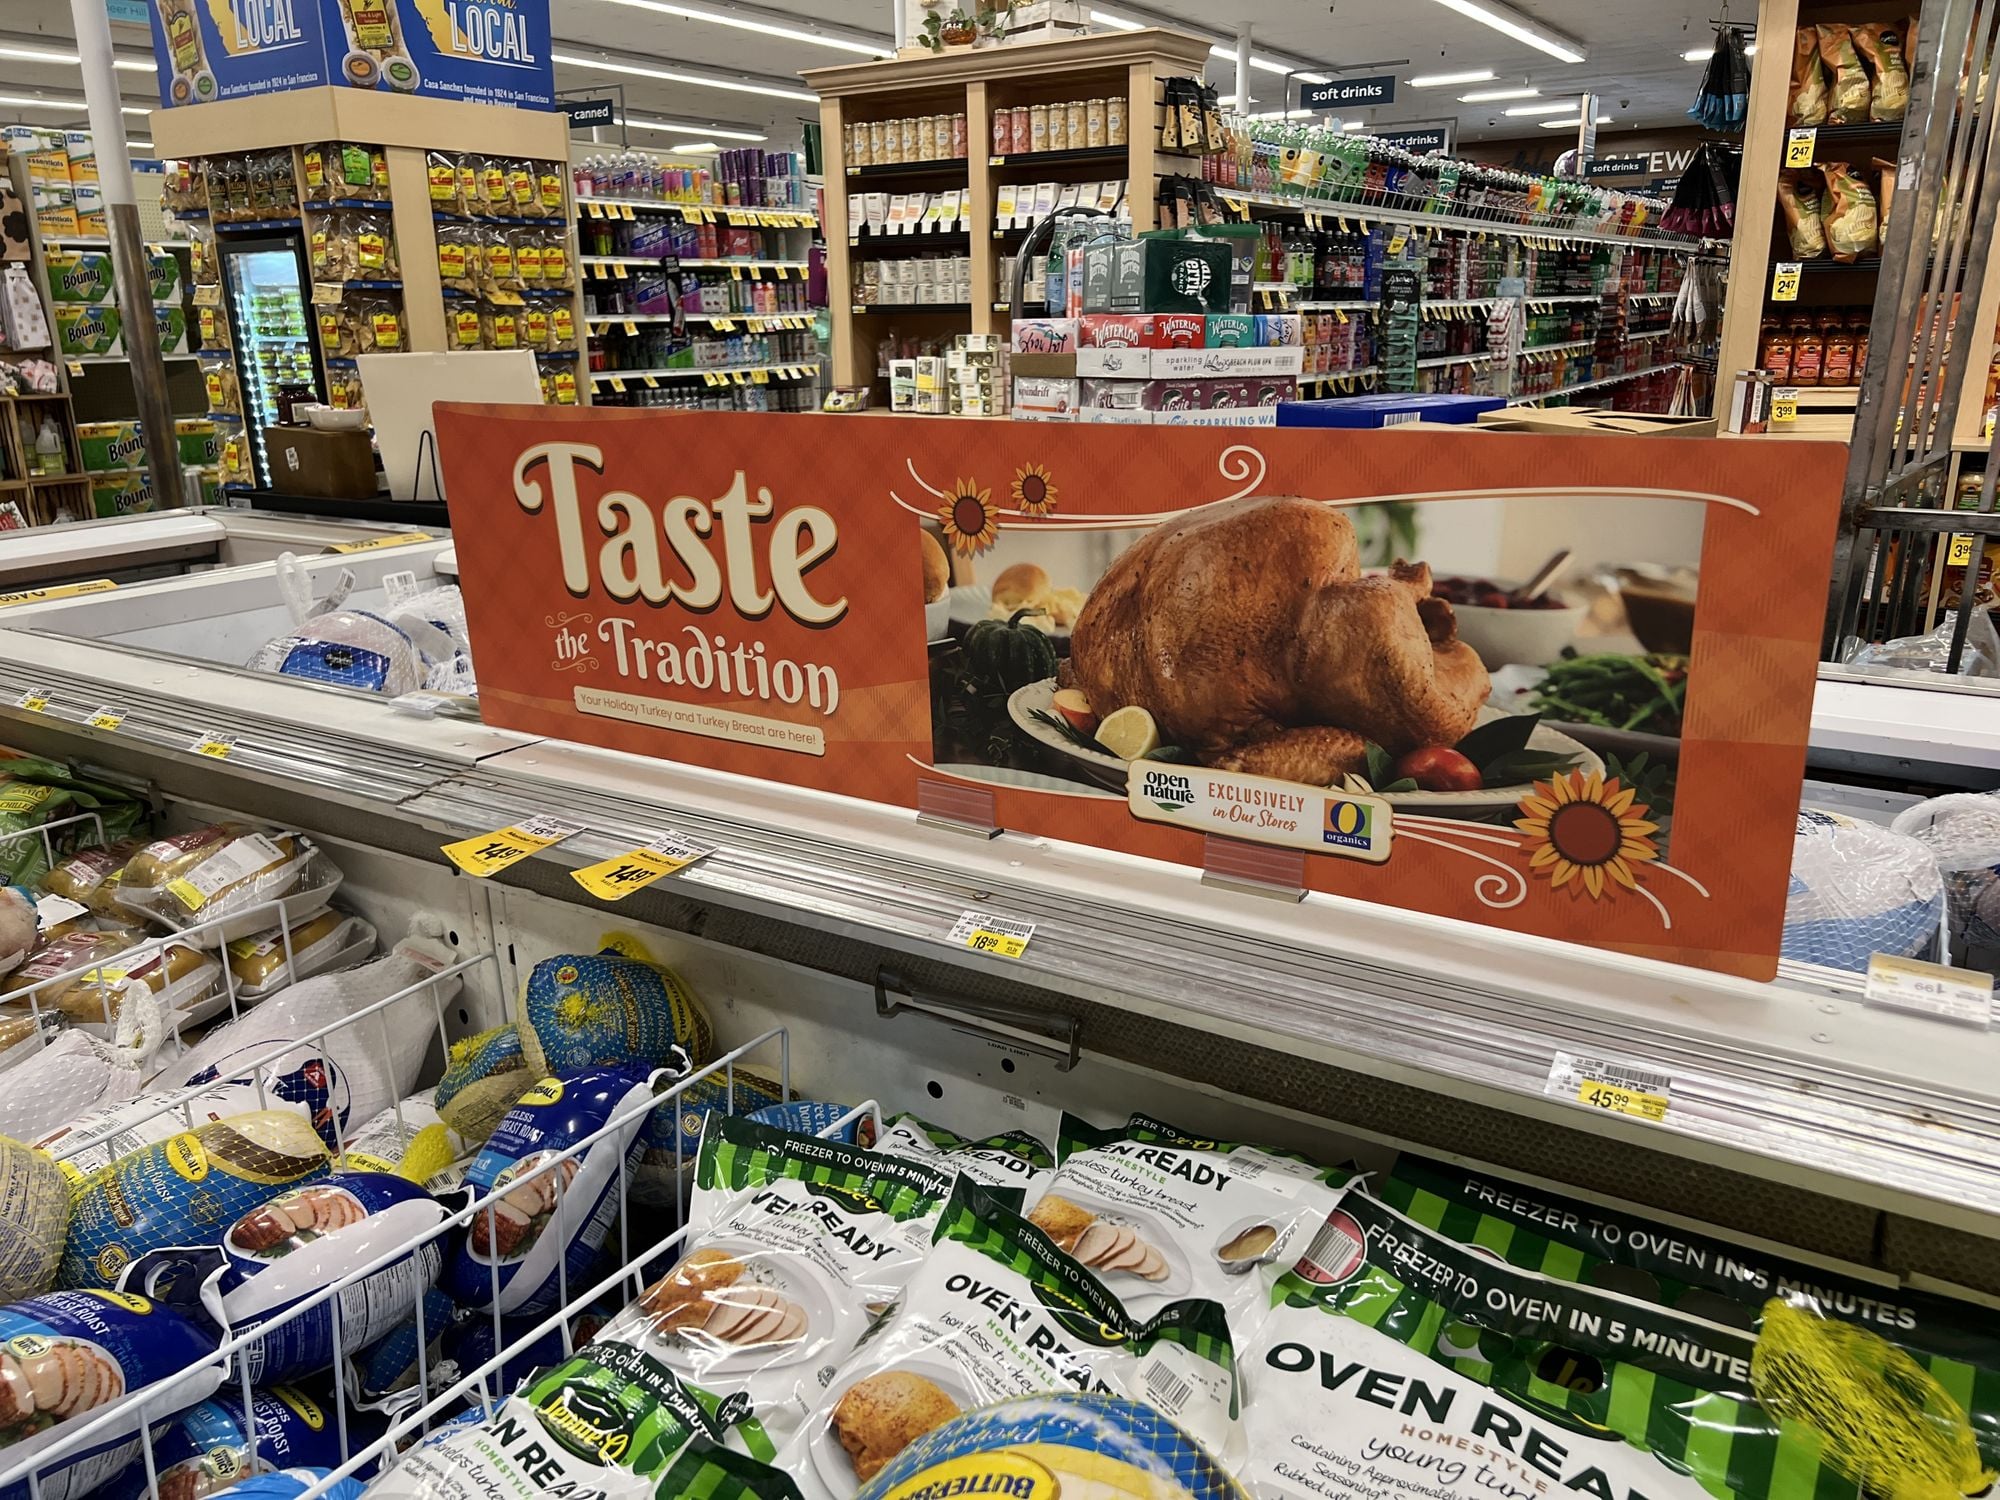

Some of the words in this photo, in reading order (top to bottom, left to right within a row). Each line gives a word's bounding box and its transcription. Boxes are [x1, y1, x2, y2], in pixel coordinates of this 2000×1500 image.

[234, 0, 301, 49] LOCAL
[449, 2, 535, 63] LOCAL
[231, 81, 249, 94] Sanchez
[249, 80, 266, 92] founded
[271, 76, 282, 88] 1924
[288, 74, 296, 86] San
[296, 72, 318, 84] Francisco
[424, 78, 439, 91] Casa
[439, 80, 463, 94] Sanchez
[464, 84, 486, 96] founded
[487, 87, 494, 97] in
[494, 88, 507, 98] 1924
[508, 89, 514, 99] in
[514, 90, 525, 101] San
[525, 92, 549, 104] Francisco
[1312, 88, 1339, 101] soft
[1340, 85, 1383, 99] drinks
[574, 106, 609, 121] canned
[1406, 136, 1439, 146] drinks
[1592, 164, 1610, 173] soft
[1611, 163, 1640, 172] drinks
[62, 268, 101, 290] Bounty
[68, 320, 106, 343] Bounty
[1092, 320, 1139, 348] WATERLOO
[1159, 316, 1201, 339] WATERLOO
[1209, 315, 1249, 339] WATERLOO
[1166, 356, 1203, 366] sparkling
[1018, 386, 1050, 398] spindrift
[1193, 416, 1255, 426] SPARKLING
[108, 435, 145, 463] Bount
[513, 441, 849, 626] Taste
[555, 628, 590, 660] the
[598, 617, 840, 715] Tradition
[580, 693, 602, 706] Your
[604, 698, 639, 715] Holiday
[641, 704, 673, 722] Turkey
[675, 711, 695, 723] and
[697, 713, 730, 731] Turkey
[732, 720, 765, 736] Breast
[768, 728, 786, 739] are
[788, 730, 816, 745] here!
[1143, 784, 1195, 804] nature
[1146, 771, 1189, 789] open
[1208, 782, 1305, 812] EXCLUSIVELY
[1213, 807, 1227, 819] in
[1229, 805, 1255, 824] Our
[1259, 809, 1298, 832] Stores
[1330, 801, 1365, 835] O
[507, 831, 532, 845] Member
[1326, 832, 1368, 846] organics
[638, 852, 662, 866] Member
[1129, 1117, 1158, 1131] EZER
[1160, 1126, 1176, 1138] TO
[784, 1140, 833, 1161] FREEZER
[836, 1151, 852, 1165] TO
[854, 1156, 886, 1174] OVEN
[886, 1163, 896, 1175] IN
[897, 1166, 905, 1177] 5
[905, 1169, 950, 1196] MINUTE
[1098, 1144, 1135, 1156] EN
[1135, 1148, 1232, 1192] READY
[1100, 1154, 1167, 1186] HOMESTYLE
[1111, 1167, 1154, 1196] turkey
[1155, 1188, 1198, 1213] breast
[751, 1191, 803, 1216] VEN
[806, 1200, 897, 1261] READY
[1464, 1179, 1579, 1233] FREEZER
[1589, 1219, 1621, 1244] TO
[1628, 1232, 1706, 1269] OVEN
[1714, 1255, 1746, 1281] IN
[1752, 1269, 1769, 1289] 5
[1776, 1277, 1917, 1330] MINUTES
[1017, 1228, 1061, 1272] FREEZER
[1063, 1264, 1080, 1283] TO
[1080, 1278, 1107, 1310] OVEN
[1107, 1305, 1119, 1324] IN
[1366, 1223, 1455, 1286] FREEZER
[1455, 1272, 1479, 1299] TO
[1486, 1288, 1563, 1324] OVEN
[1568, 1308, 1603, 1338] IN
[1606, 1322, 1627, 1343] 5
[945, 1273, 1031, 1335] OVEN
[74, 1306, 111, 1335] ROAST
[986, 1318, 1056, 1387] HOMESTYLE
[617, 1354, 648, 1381] OVEN
[647, 1371, 664, 1388] IN
[664, 1385, 674, 1400] 5
[264, 1416, 291, 1456] ROAST
[1266, 1342, 1457, 1424] OVEN
[1470, 1401, 1647, 1500] REA
[1291, 1434, 1361, 1479] Containing
[1361, 1437, 1467, 1485] young
[1400, 1423, 1550, 1494] HOMESTYLE
[1273, 1462, 1324, 1500] Rubbed
